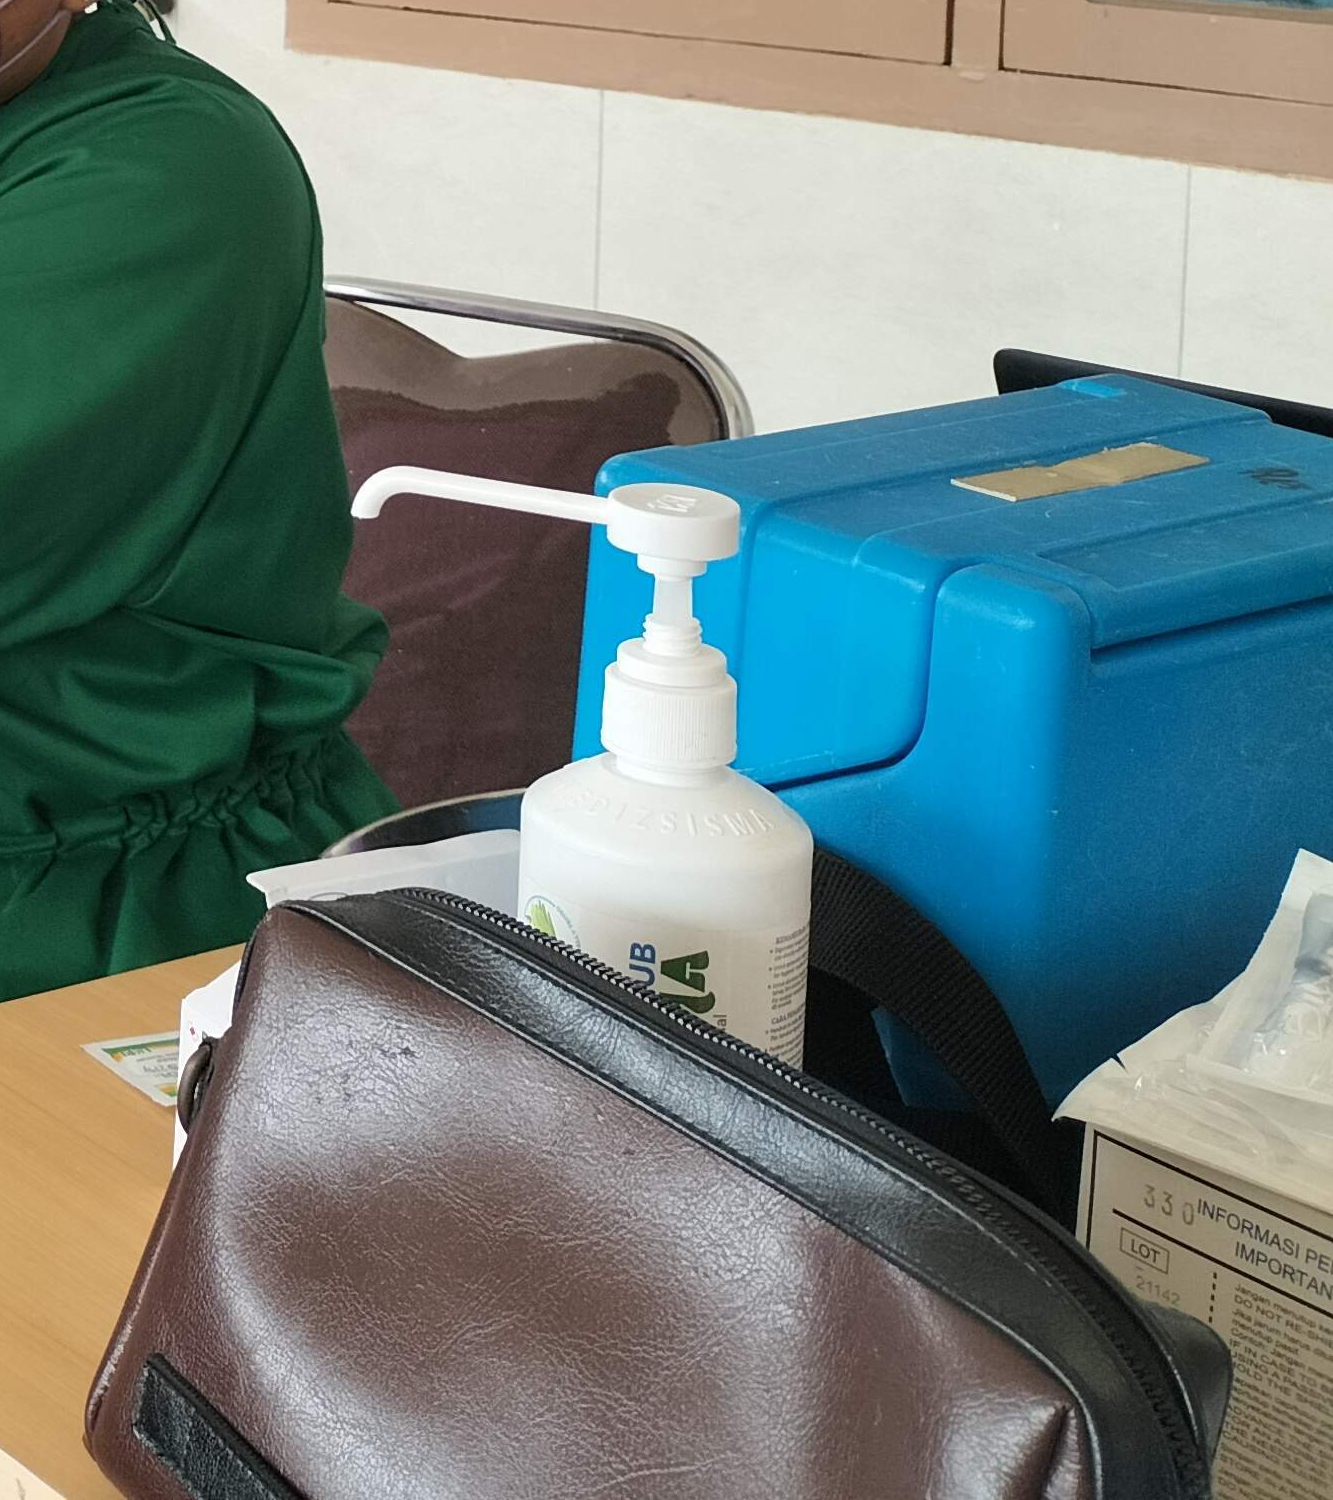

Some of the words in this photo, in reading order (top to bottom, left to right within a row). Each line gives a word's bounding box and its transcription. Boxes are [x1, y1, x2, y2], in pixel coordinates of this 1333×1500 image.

[1131, 1238, 1160, 1264] LOT
[1197, 1198, 1300, 1259] INFORMASI
[1305, 1247, 1333, 1275] PE
[1235, 1241, 1333, 1300] IMPORTAN
[1234, 1293, 1252, 1309] DO
